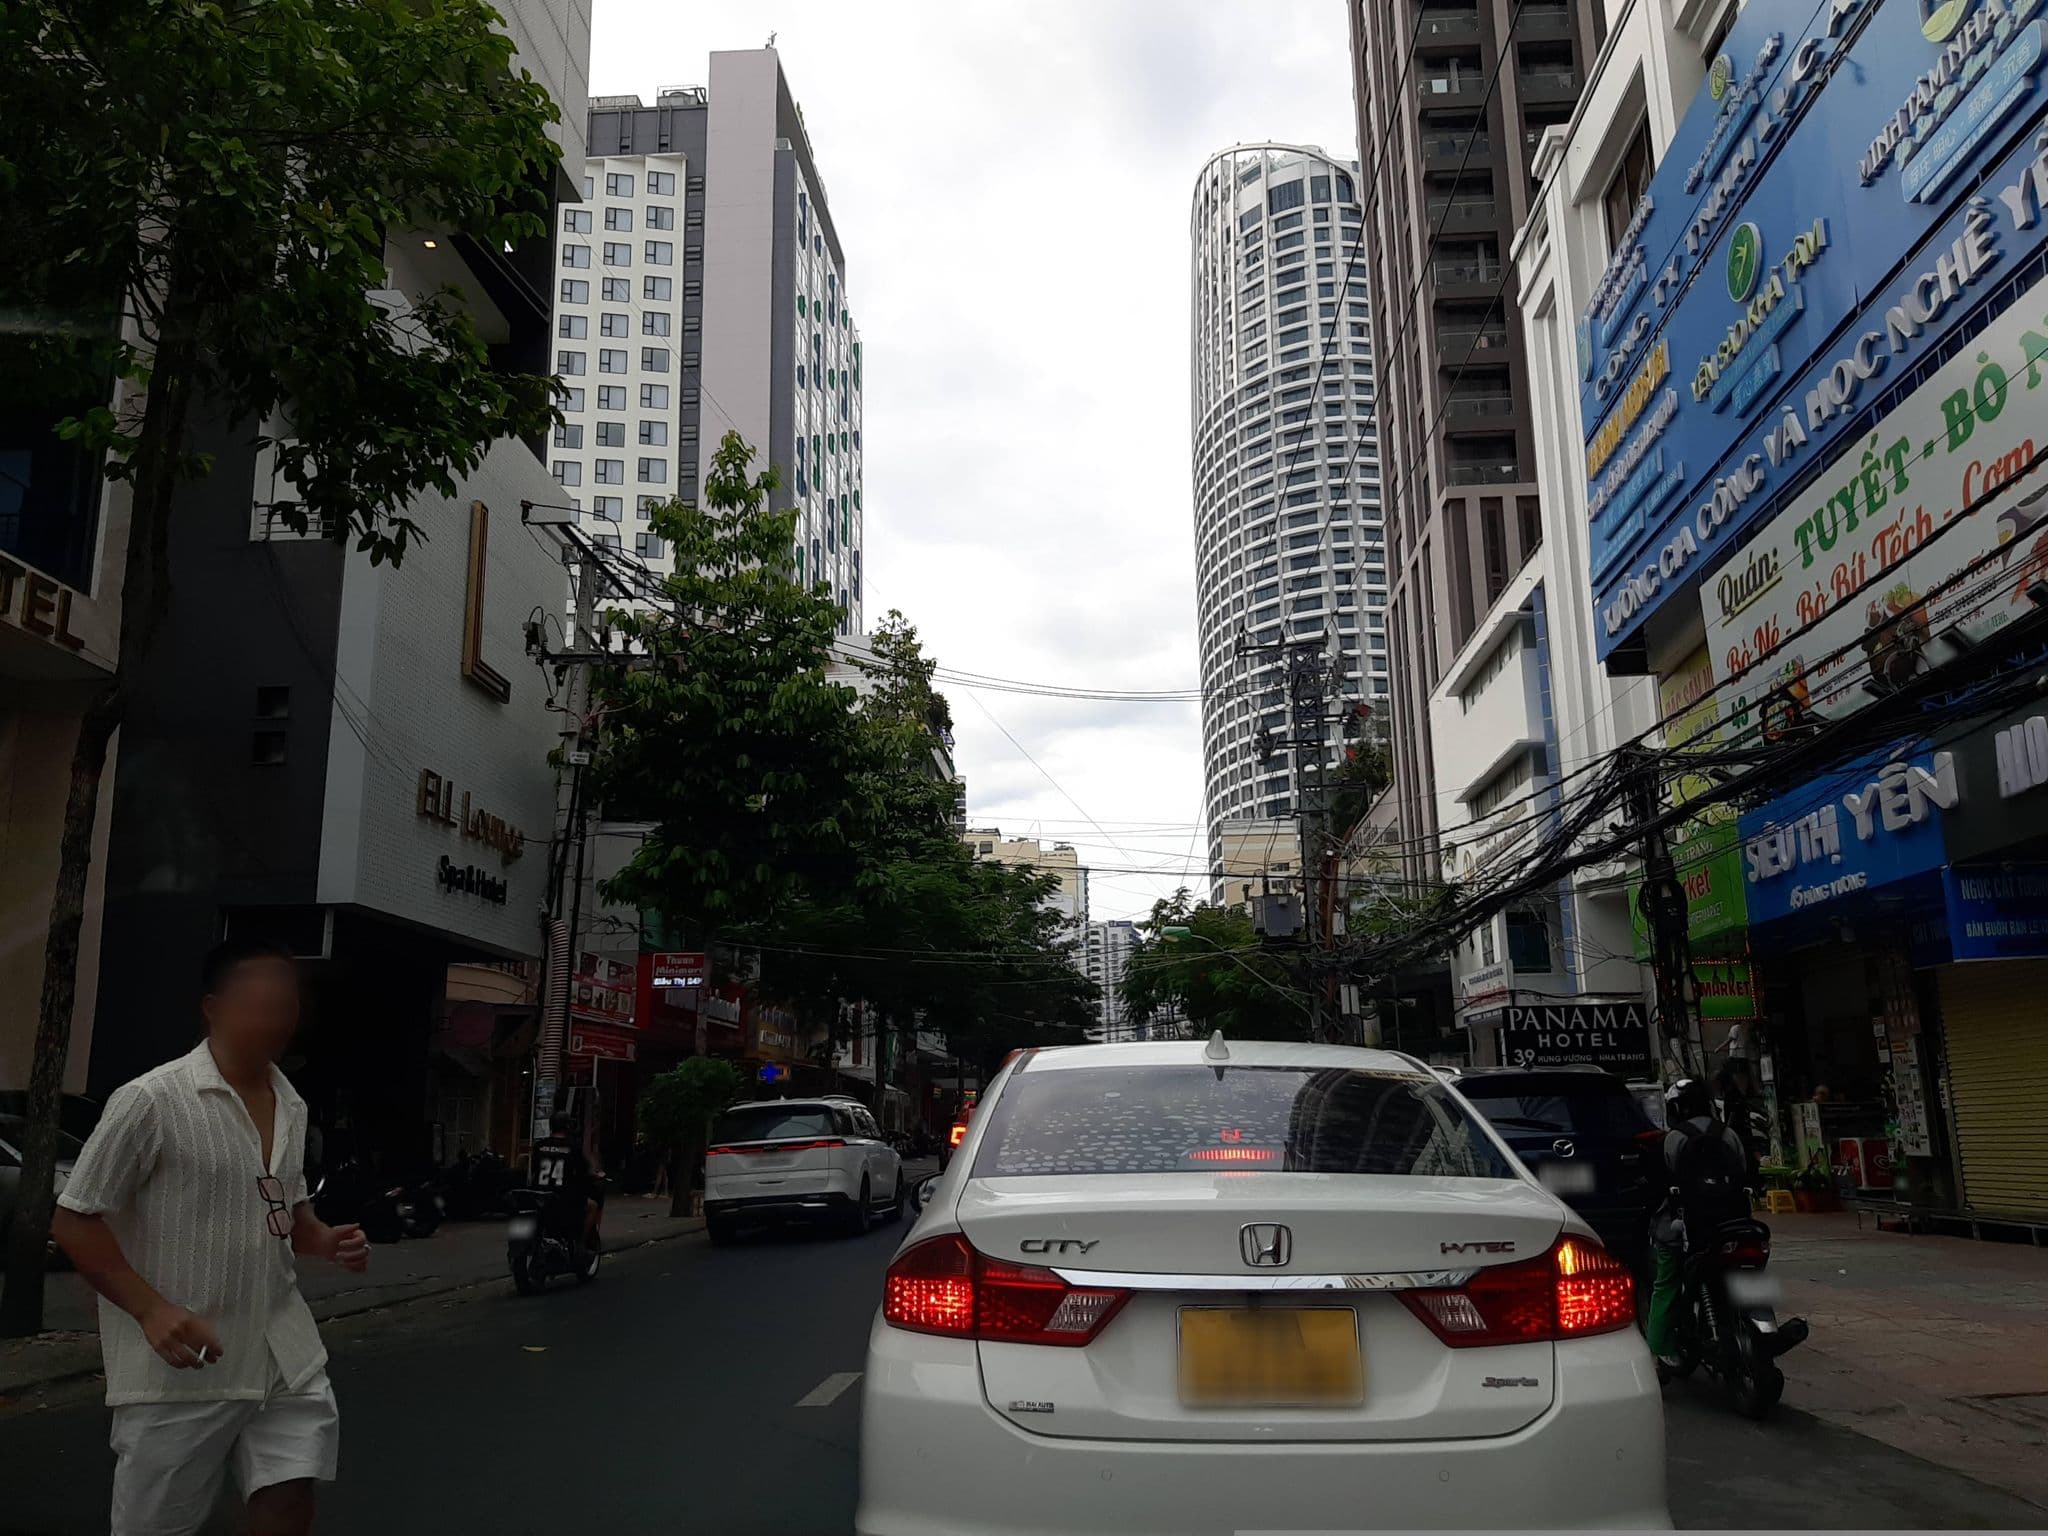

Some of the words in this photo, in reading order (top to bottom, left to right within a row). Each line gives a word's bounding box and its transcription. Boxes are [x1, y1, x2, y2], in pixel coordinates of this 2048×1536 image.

[1858, 109, 1911, 188] MINH
[1696, 453, 1765, 541] CÔNG
[1764, 404, 1808, 468] VÀ
[1805, 331, 1886, 431] HỌC
[1886, 196, 1999, 354] NGHỀ
[1794, 432, 1911, 570] TUYẾT
[1941, 351, 2008, 453] BÒ
[1796, 580, 1830, 628] Bò
[1831, 552, 1866, 603] Bít
[1871, 504, 1934, 571] Tếch
[1731, 696, 1750, 729] 43
[1796, 804, 1841, 865] THỊ
[1842, 740, 1959, 842] YẾN
[438, 854, 466, 894] Spa
[475, 867, 508, 906] Hotel
[1960, 877, 1992, 905] NGỌC
[1508, 1004, 1644, 1032] PANAMA
[1514, 1049, 1536, 1064] 39
[1599, 1053, 1616, 1063] NHA
[1617, 1052, 1646, 1062] TRANG
[1538, 1032, 1618, 1048] HOTEL
[538, 1159, 565, 1186] 24
[1020, 1238, 1102, 1256] CITY
